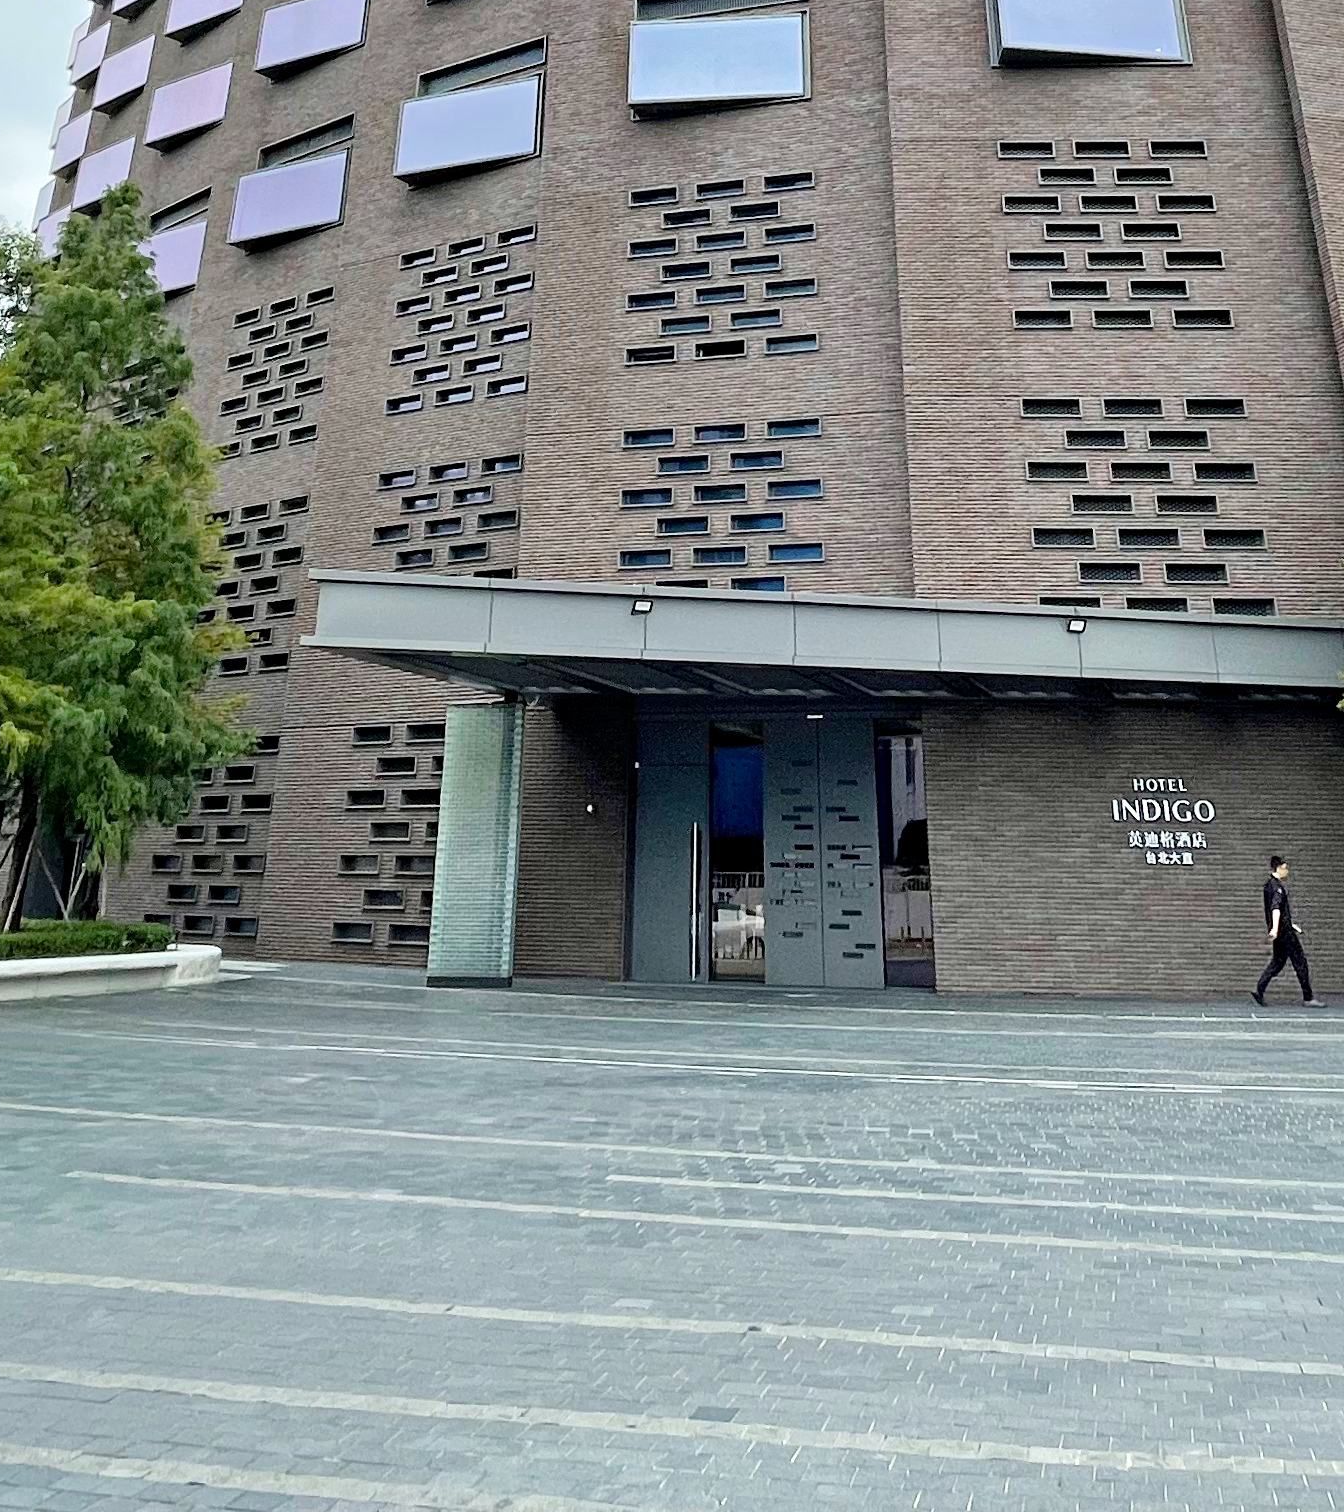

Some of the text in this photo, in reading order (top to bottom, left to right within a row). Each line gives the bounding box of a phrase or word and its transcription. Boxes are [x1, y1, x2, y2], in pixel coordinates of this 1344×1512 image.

[1133, 778, 1188, 792] HOTEL
[1112, 799, 1216, 822] INDIGO
[1128, 830, 1208, 849] 英迪格酒店
[1145, 850, 1194, 865] 台北大直
